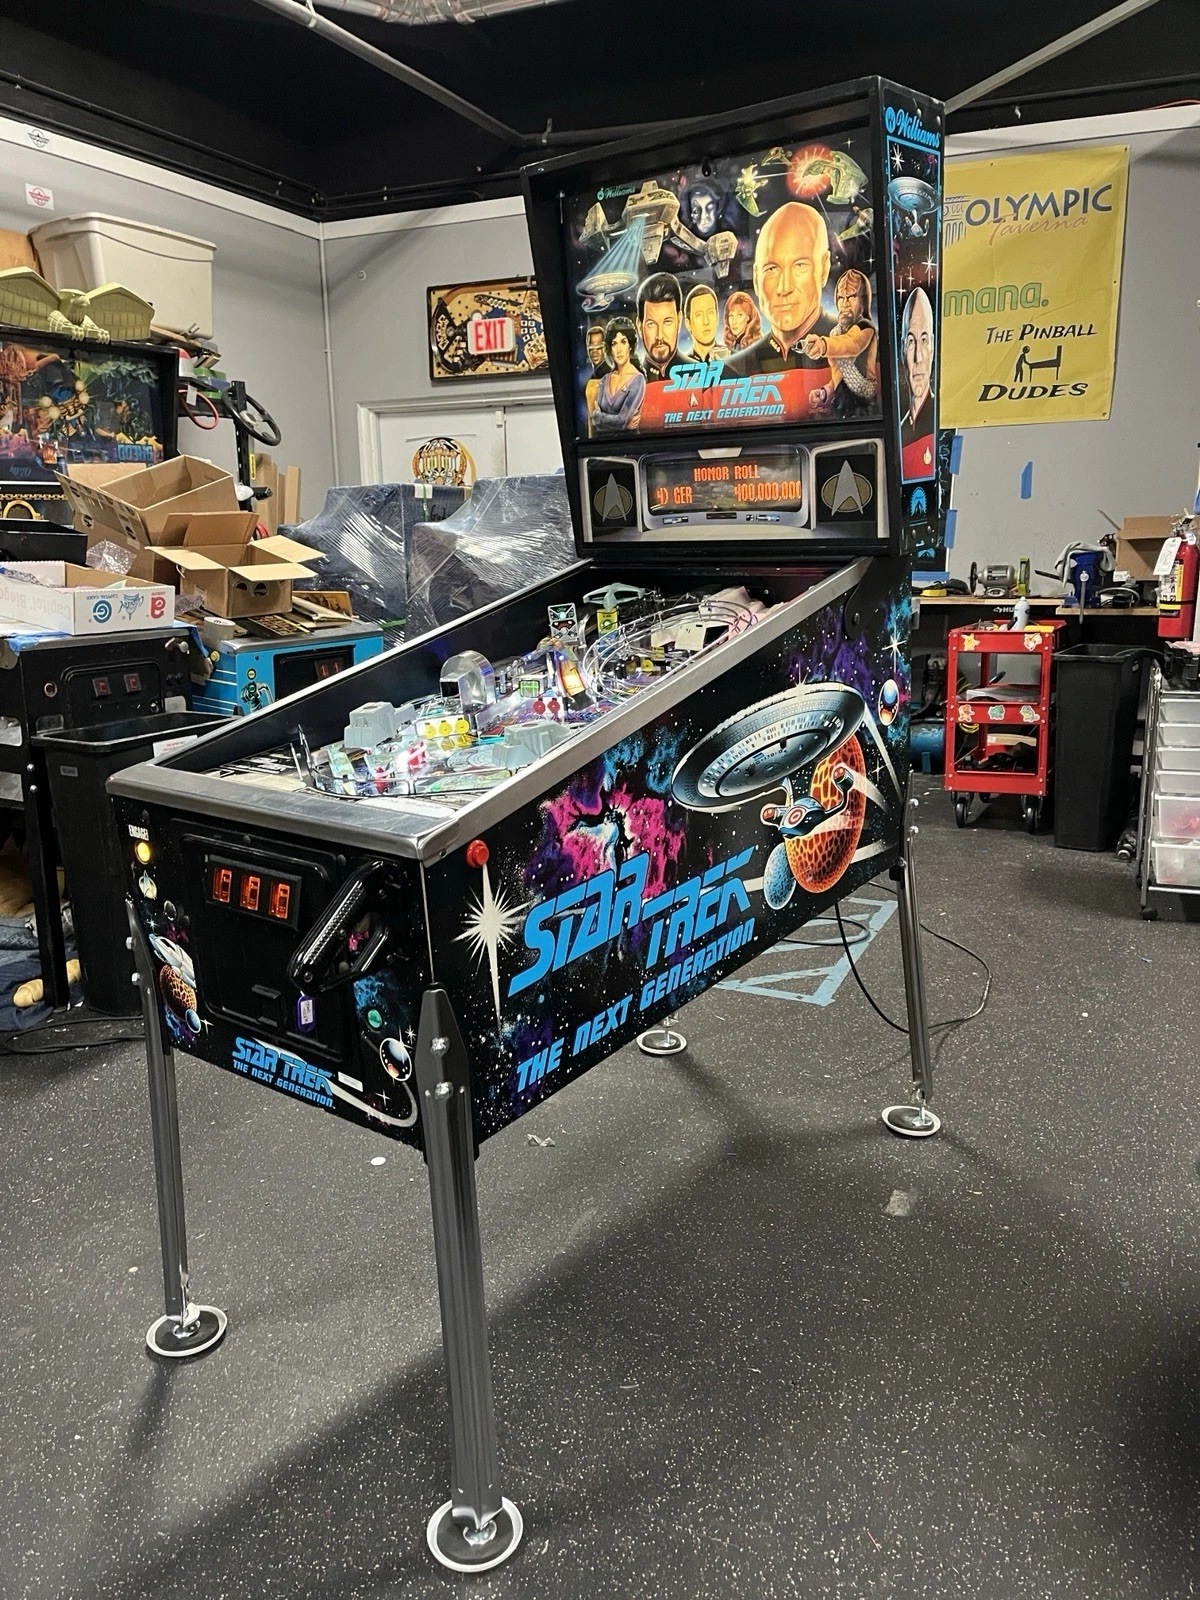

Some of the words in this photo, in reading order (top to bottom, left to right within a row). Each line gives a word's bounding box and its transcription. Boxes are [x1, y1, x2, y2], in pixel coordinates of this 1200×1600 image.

[896, 108, 941, 149] Williams
[965, 184, 1112, 226] OLYMPIC
[987, 212, 1088, 247] Taverna
[474, 319, 506, 352] EXIT
[1018, 323, 1098, 341] PINBALL
[663, 360, 725, 393] STAR
[719, 373, 786, 406] TREK
[978, 382, 1089, 402] DUDES
[664, 412, 683, 423] THE
[686, 409, 713, 422] NEXT
[717, 403, 785, 419] GENERATION
[694, 466, 729, 482] HONOR
[734, 465, 760, 480] ROLL
[673, 486, 693, 505] GER
[641, 845, 755, 969] TREK
[507, 852, 650, 998] STAR
[517, 1037, 564, 1093] THE
[572, 995, 633, 1056] NEXT
[639, 917, 755, 1011] GENERATION
[232, 1037, 279, 1073] STAR
[279, 1052, 333, 1096] TREK
[232, 1059, 249, 1073] THE
[251, 1068, 274, 1083] NEXT
[276, 1077, 334, 1108] GENERATION
